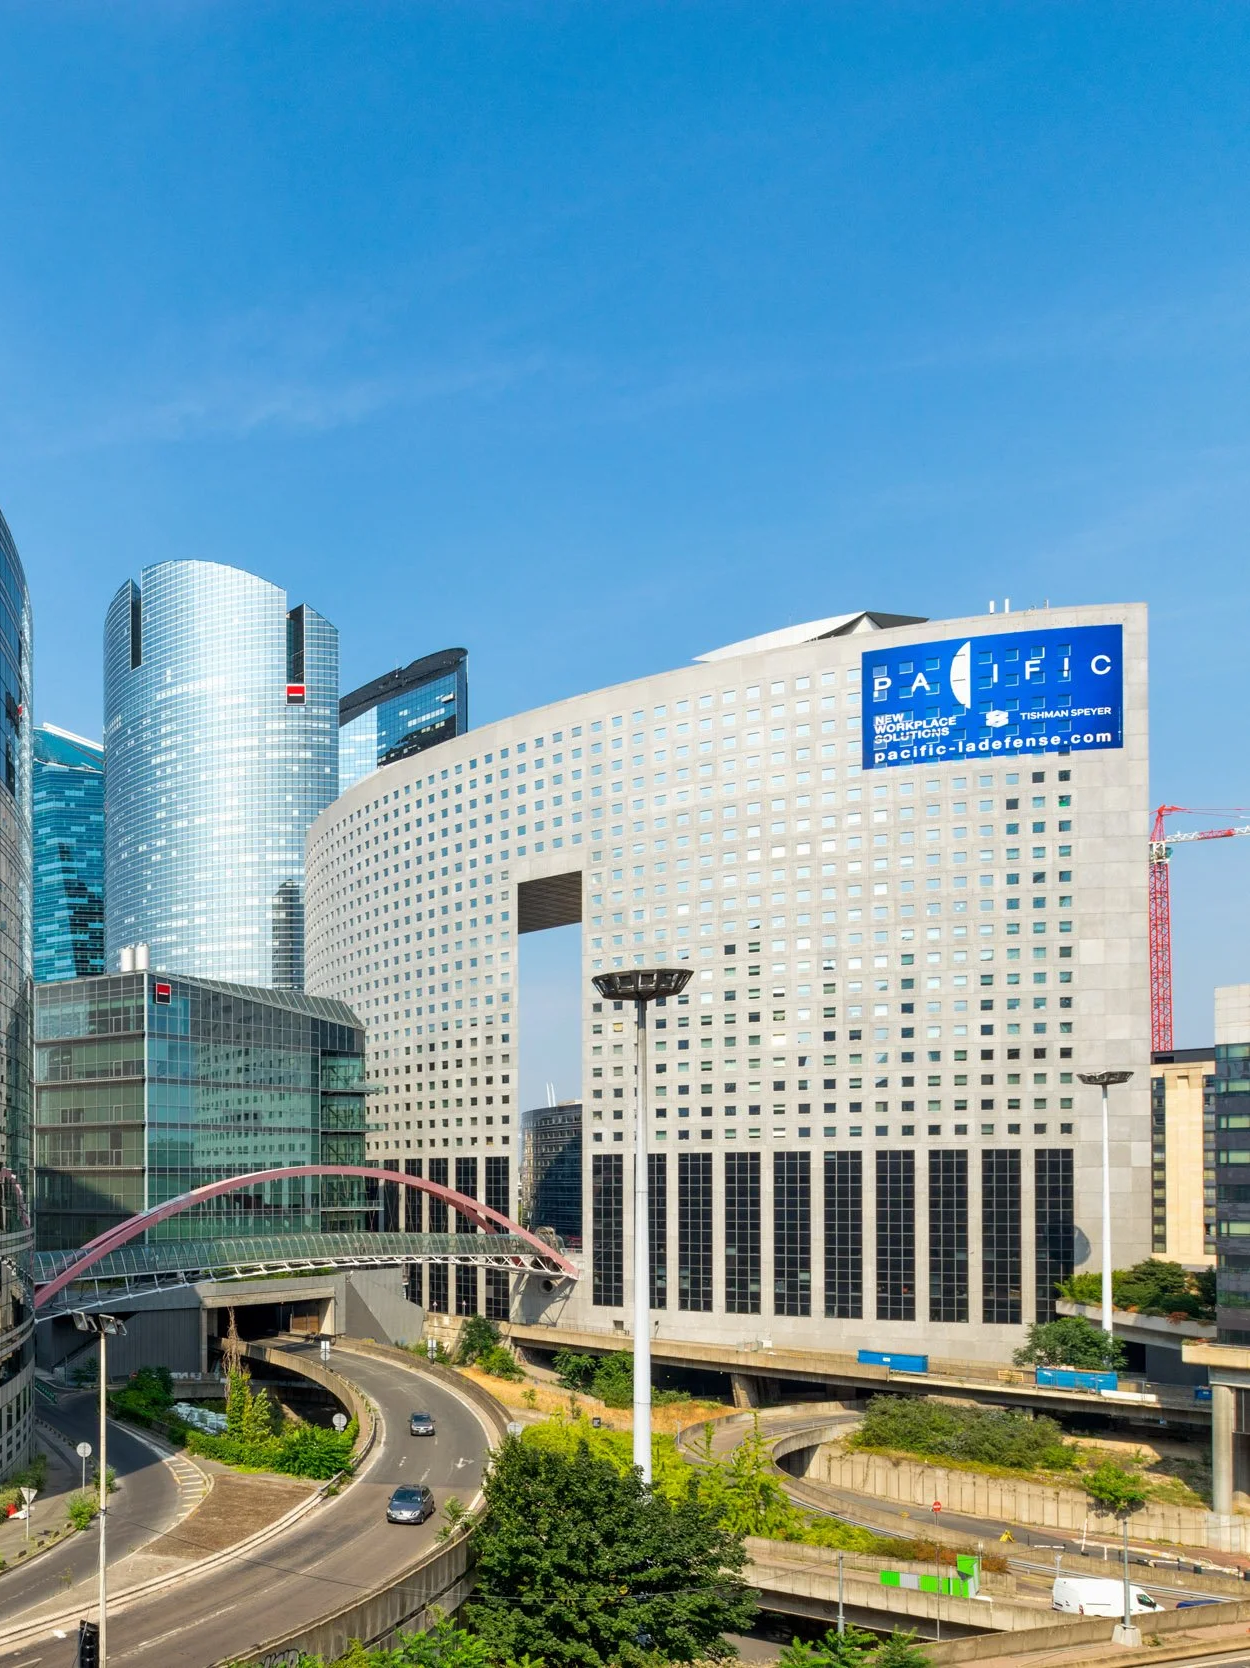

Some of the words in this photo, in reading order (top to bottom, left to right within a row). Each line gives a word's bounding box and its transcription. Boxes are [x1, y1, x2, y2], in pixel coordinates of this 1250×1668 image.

[875, 713, 905, 726] NEW
[1020, 709, 1069, 720] TISHMAN
[1070, 706, 1112, 717] SPEYER
[874, 716, 957, 735] WORKPLACE
[874, 727, 950, 745] SOLUTIONS
[874, 731, 1112, 764] pacific-ladefense.com
